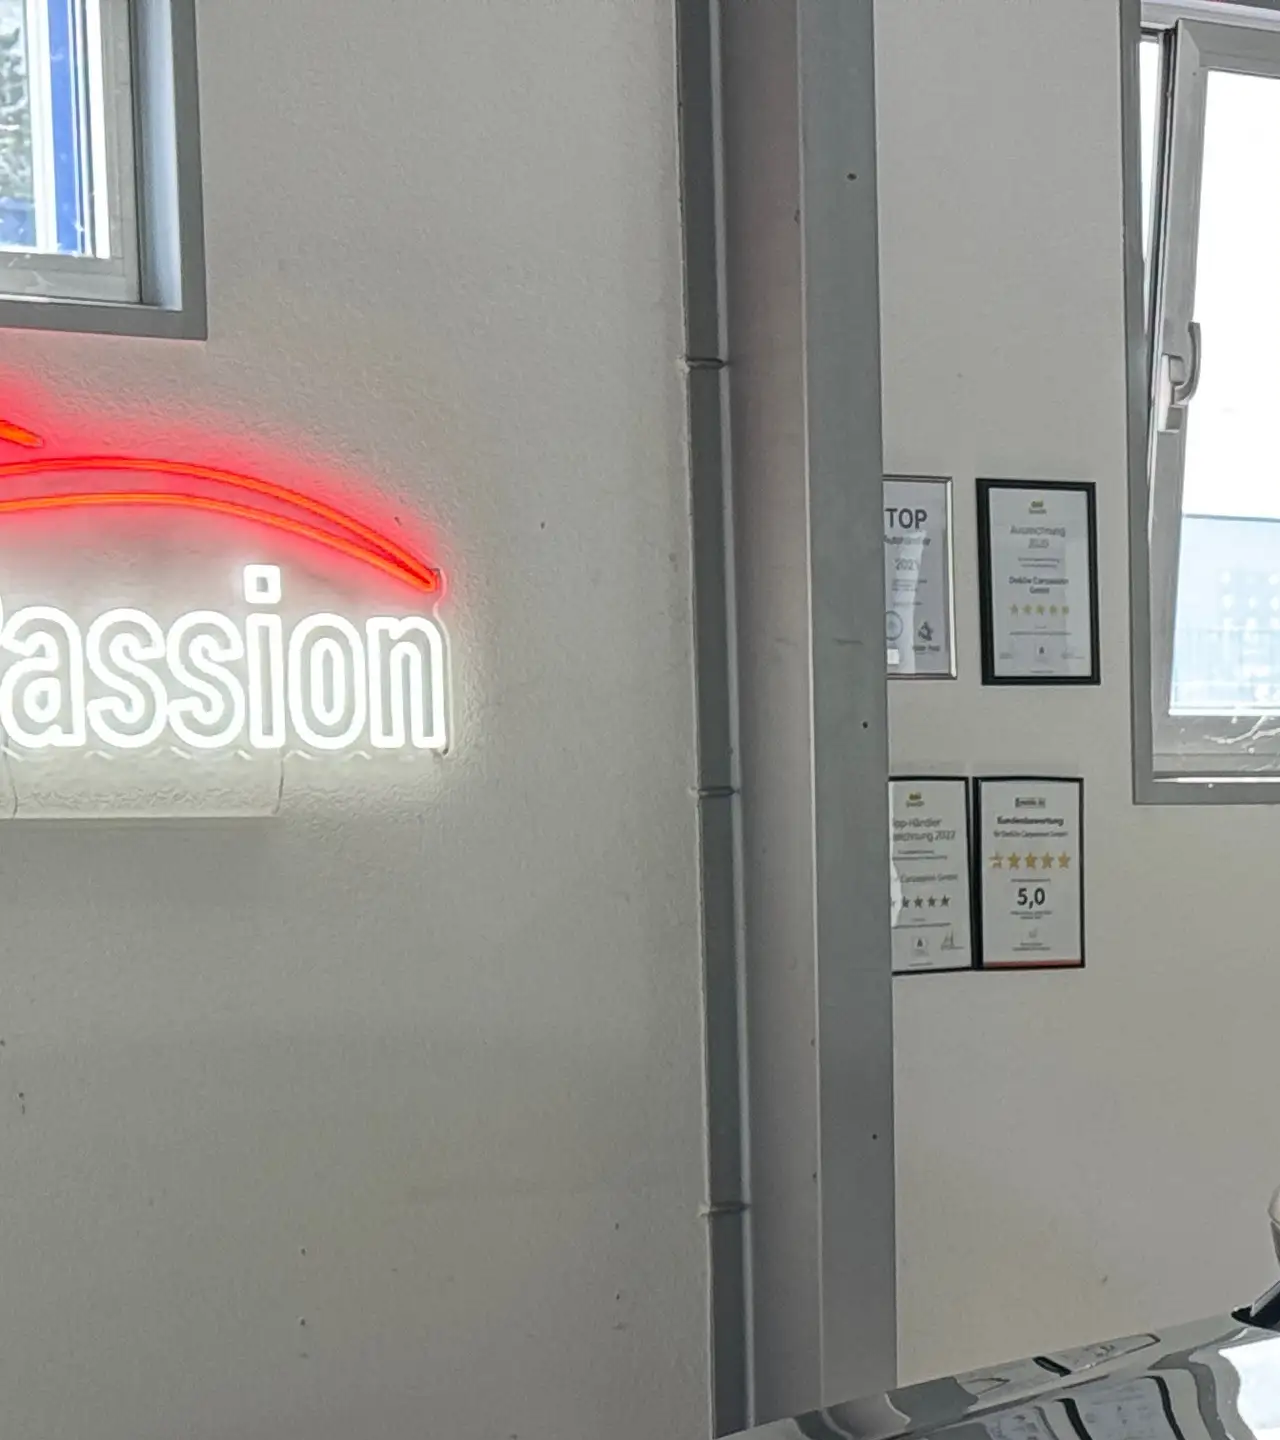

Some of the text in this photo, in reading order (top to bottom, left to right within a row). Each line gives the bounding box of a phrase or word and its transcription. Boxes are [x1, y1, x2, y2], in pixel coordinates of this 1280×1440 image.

[884, 508, 928, 529] TOP
[0, 564, 446, 749] assion
[1017, 887, 1046, 910] 5,0
